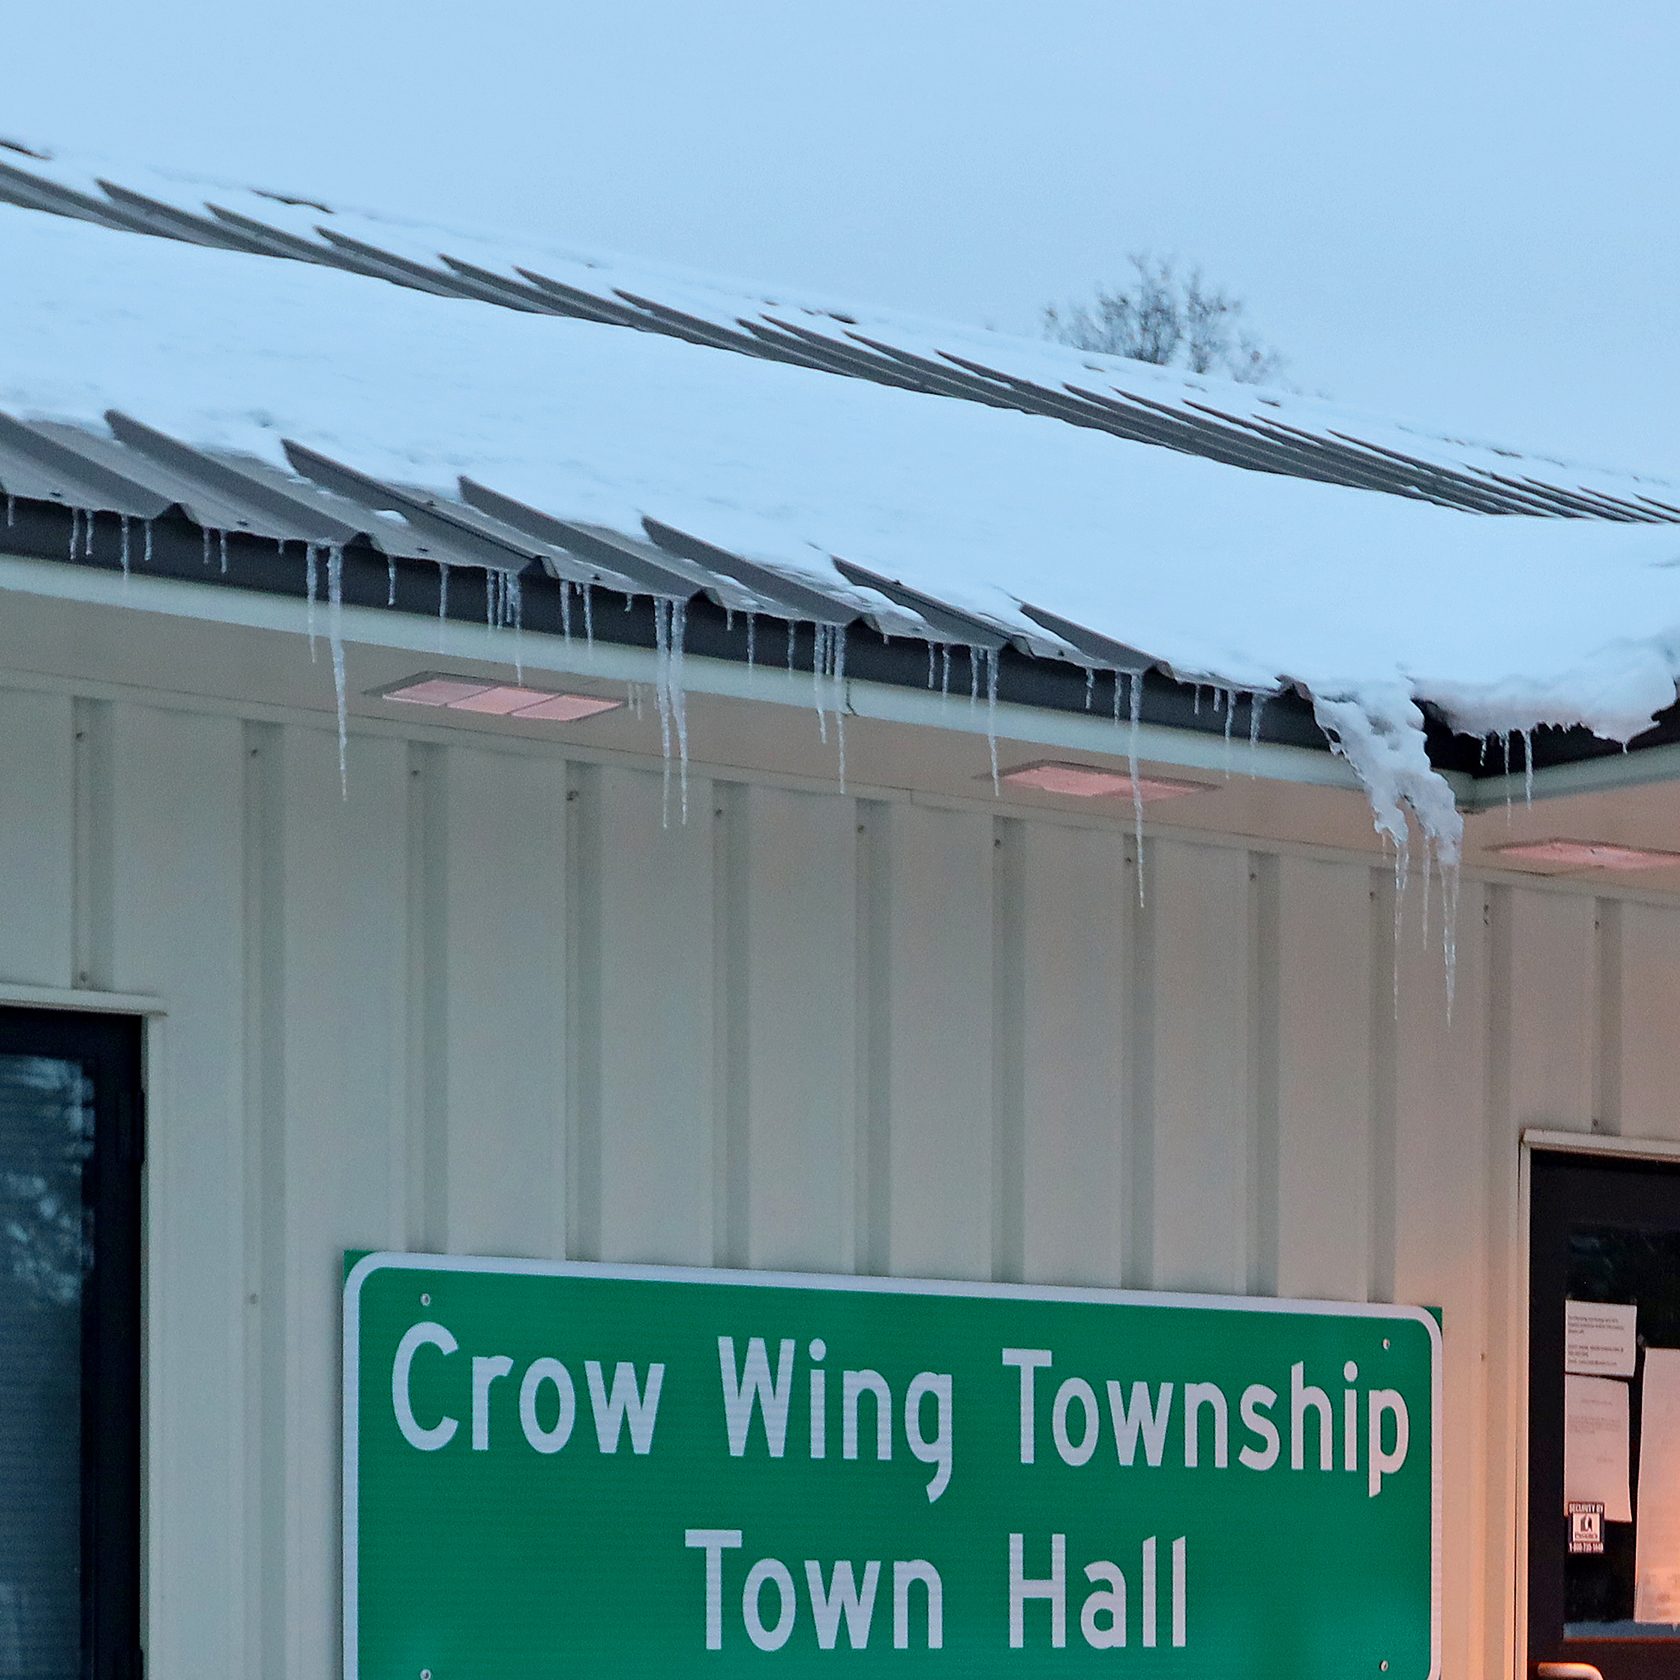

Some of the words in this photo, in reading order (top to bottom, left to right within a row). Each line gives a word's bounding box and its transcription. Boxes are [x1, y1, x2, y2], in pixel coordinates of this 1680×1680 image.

[391, 1321, 665, 1455] Crow
[718, 1335, 954, 1503] Wing
[1002, 1347, 1410, 1498] Township
[685, 1529, 943, 1651] Town
[1009, 1533, 1187, 1648] Hall
